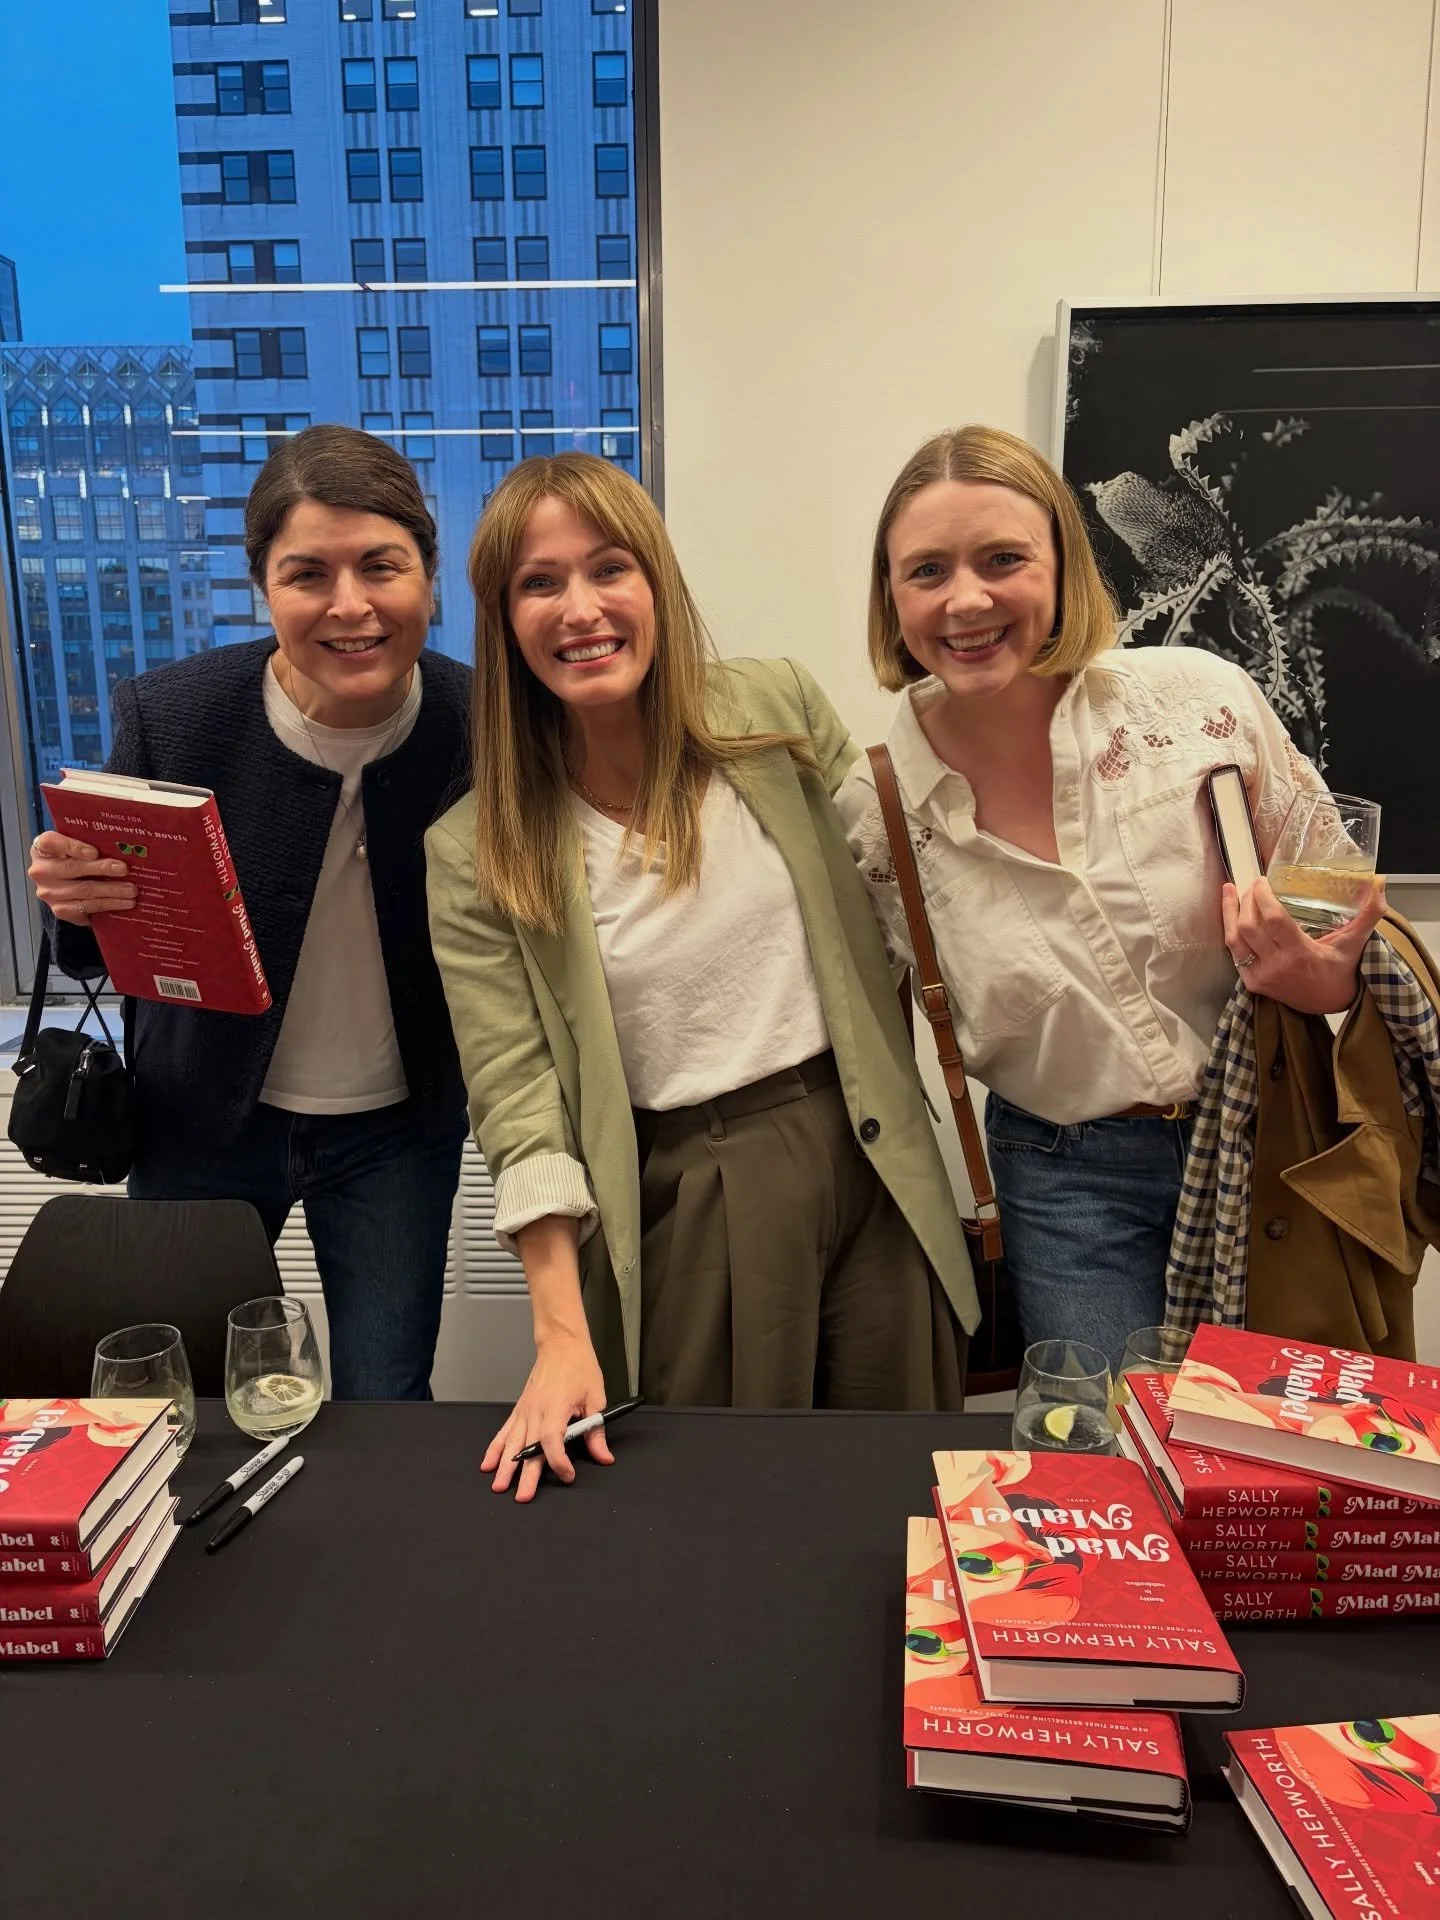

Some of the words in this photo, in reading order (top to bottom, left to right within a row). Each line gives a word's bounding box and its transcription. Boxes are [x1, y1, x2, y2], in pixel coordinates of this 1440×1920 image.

[64, 816, 88, 828] Sally
[92, 821, 152, 836] Hepworth's
[155, 832, 188, 841] novels
[202, 814, 230, 884] HEPWORTH
[217, 825, 232, 860] SALLY
[232, 904, 250, 939] Mad
[244, 940, 264, 985] Mabel
[1279, 1348, 1324, 1422] Mabel
[1330, 1349, 1374, 1404] Mad
[1228, 1489, 1280, 1502] SALLY
[1202, 1507, 1304, 1518] HEPWORTH
[1344, 1496, 1400, 1514] Mad
[969, 1503, 1132, 1531] Mabel
[1216, 1524, 1267, 1537] SALLY
[1042, 1533, 1170, 1562] Mad
[1190, 1541, 1290, 1550] HEPWORTH
[1330, 1532, 1386, 1548] Mad
[0, 1558, 46, 1572] abel
[1226, 1554, 1278, 1568] SALLY
[1200, 1570, 1301, 1580] HEPWORTH
[1342, 1564, 1397, 1580] Mad
[1224, 1592, 1273, 1606] SALLY
[1336, 1594, 1388, 1614] Mad
[1214, 1609, 1296, 1620] EPWORTH
[992, 1630, 1136, 1648] HEPWORTH
[1146, 1636, 1217, 1654] SALLY
[1033, 1716, 1082, 1726] BESTSELLING
[923, 1718, 1071, 1744] HEPWORTH
[1083, 1734, 1159, 1755] SALLY
[1251, 1738, 1336, 1848] HEPWORTH
[1331, 1816, 1363, 1857] BESTSELLING
[1358, 1858, 1376, 1878] TIMES
